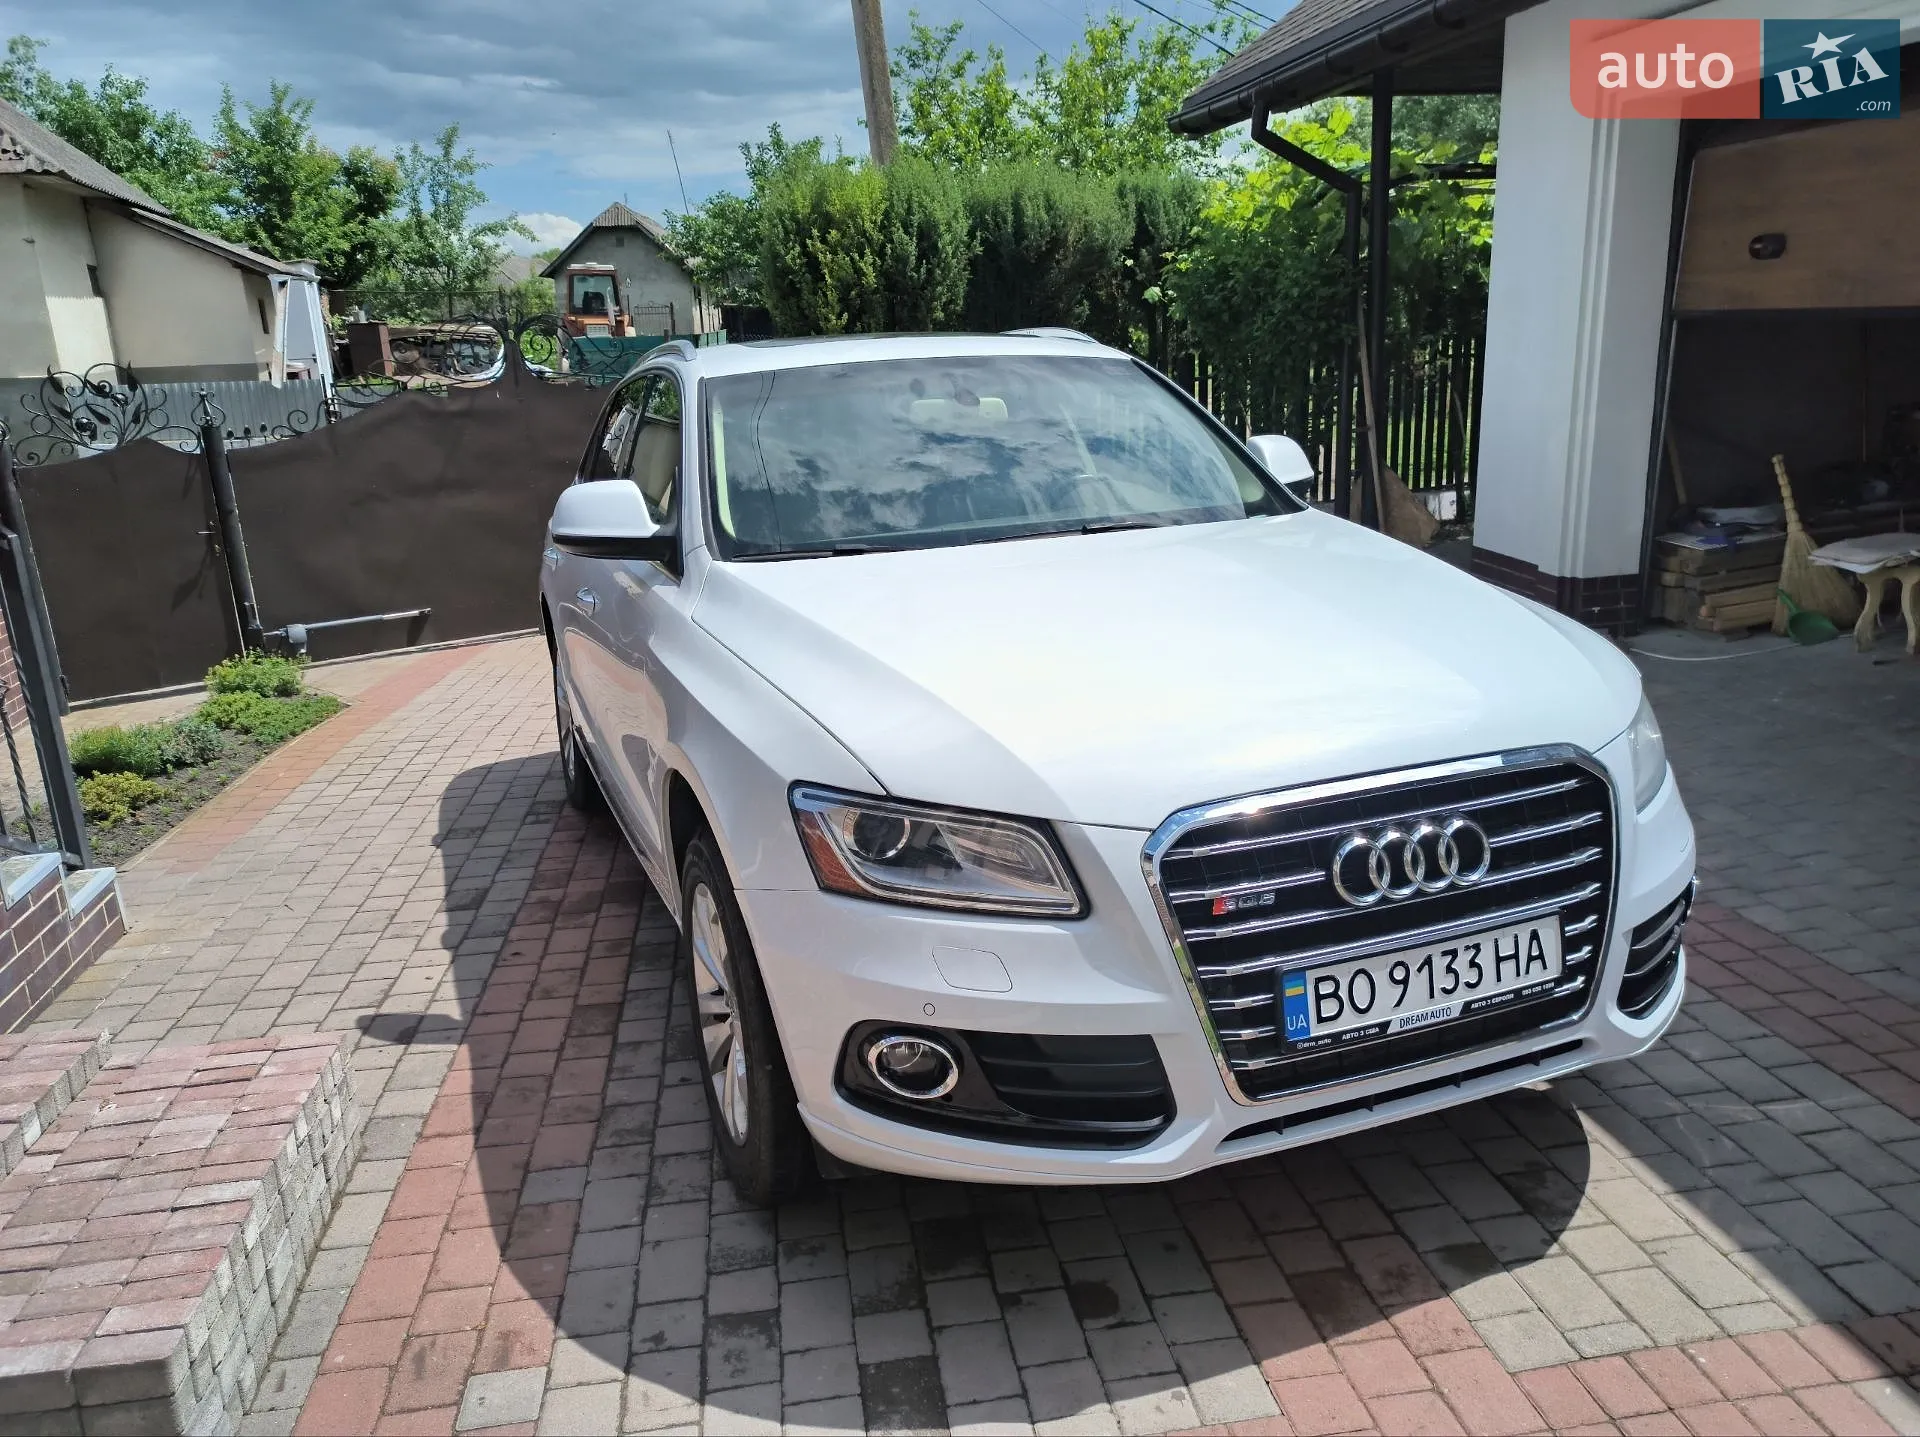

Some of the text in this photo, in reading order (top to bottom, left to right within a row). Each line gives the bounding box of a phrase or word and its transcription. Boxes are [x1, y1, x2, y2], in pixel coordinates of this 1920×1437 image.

[1313, 928, 1549, 1025] BO 9133 HA
[1286, 1012, 1308, 1031] UA
[1399, 1006, 1452, 1029] DREAM AUTO
